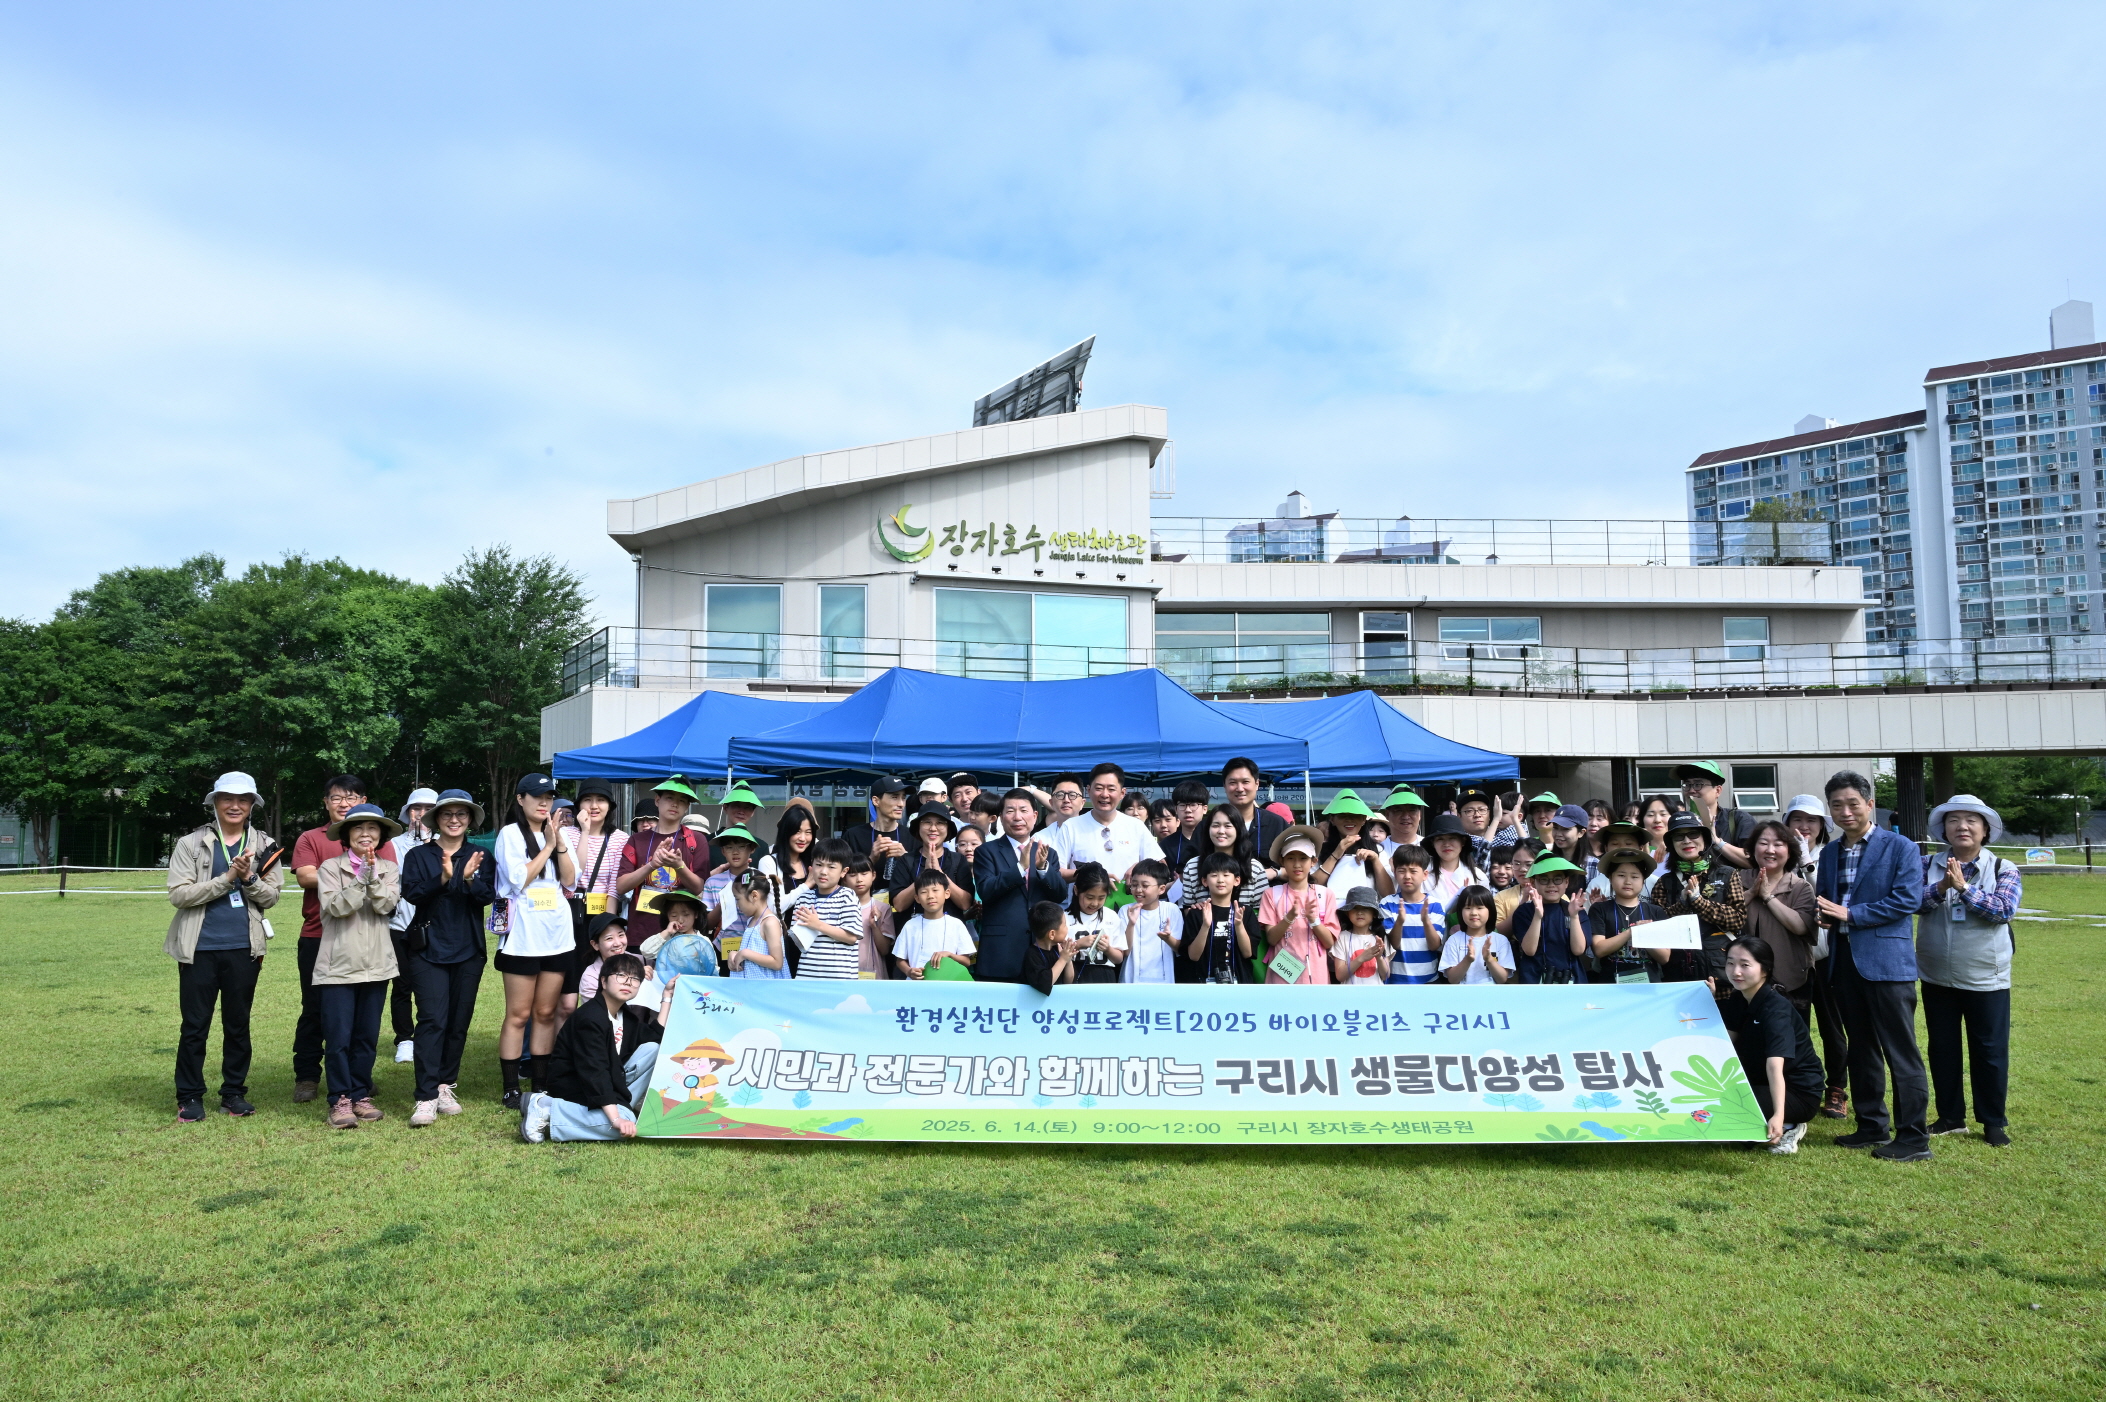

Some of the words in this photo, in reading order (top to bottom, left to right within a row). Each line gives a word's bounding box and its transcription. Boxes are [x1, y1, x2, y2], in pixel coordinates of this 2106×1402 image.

[939, 520, 1046, 562] 장자호수
[1049, 527, 1147, 554] 생태체험관
[1049, 550, 1076, 562] Jangja
[1077, 552, 1095, 562] Lake
[695, 1001, 735, 1015] 구리시
[895, 1005, 1021, 1034] 환경실천단
[1031, 1009, 1257, 1036] 양성프로젝트[2025
[1268, 1009, 1411, 1037] 바이오블리츠
[1423, 1011, 1511, 1035] 구리시]
[726, 1047, 858, 1093] 시민과
[863, 1054, 1030, 1097] 전문가와
[1038, 1055, 1204, 1098] 함께하는
[1215, 1058, 1339, 1096] 구리시
[1351, 1053, 1564, 1096] 생물다양성
[1573, 1051, 1664, 1091] 탐사
[921, 1119, 976, 1133] 2025.
[984, 1120, 1002, 1133] 6.
[1014, 1120, 1078, 1135] 14.(토)
[1236, 1121, 1298, 1135] 구리시
[1307, 1120, 1475, 1135] 장자호수생태공원
